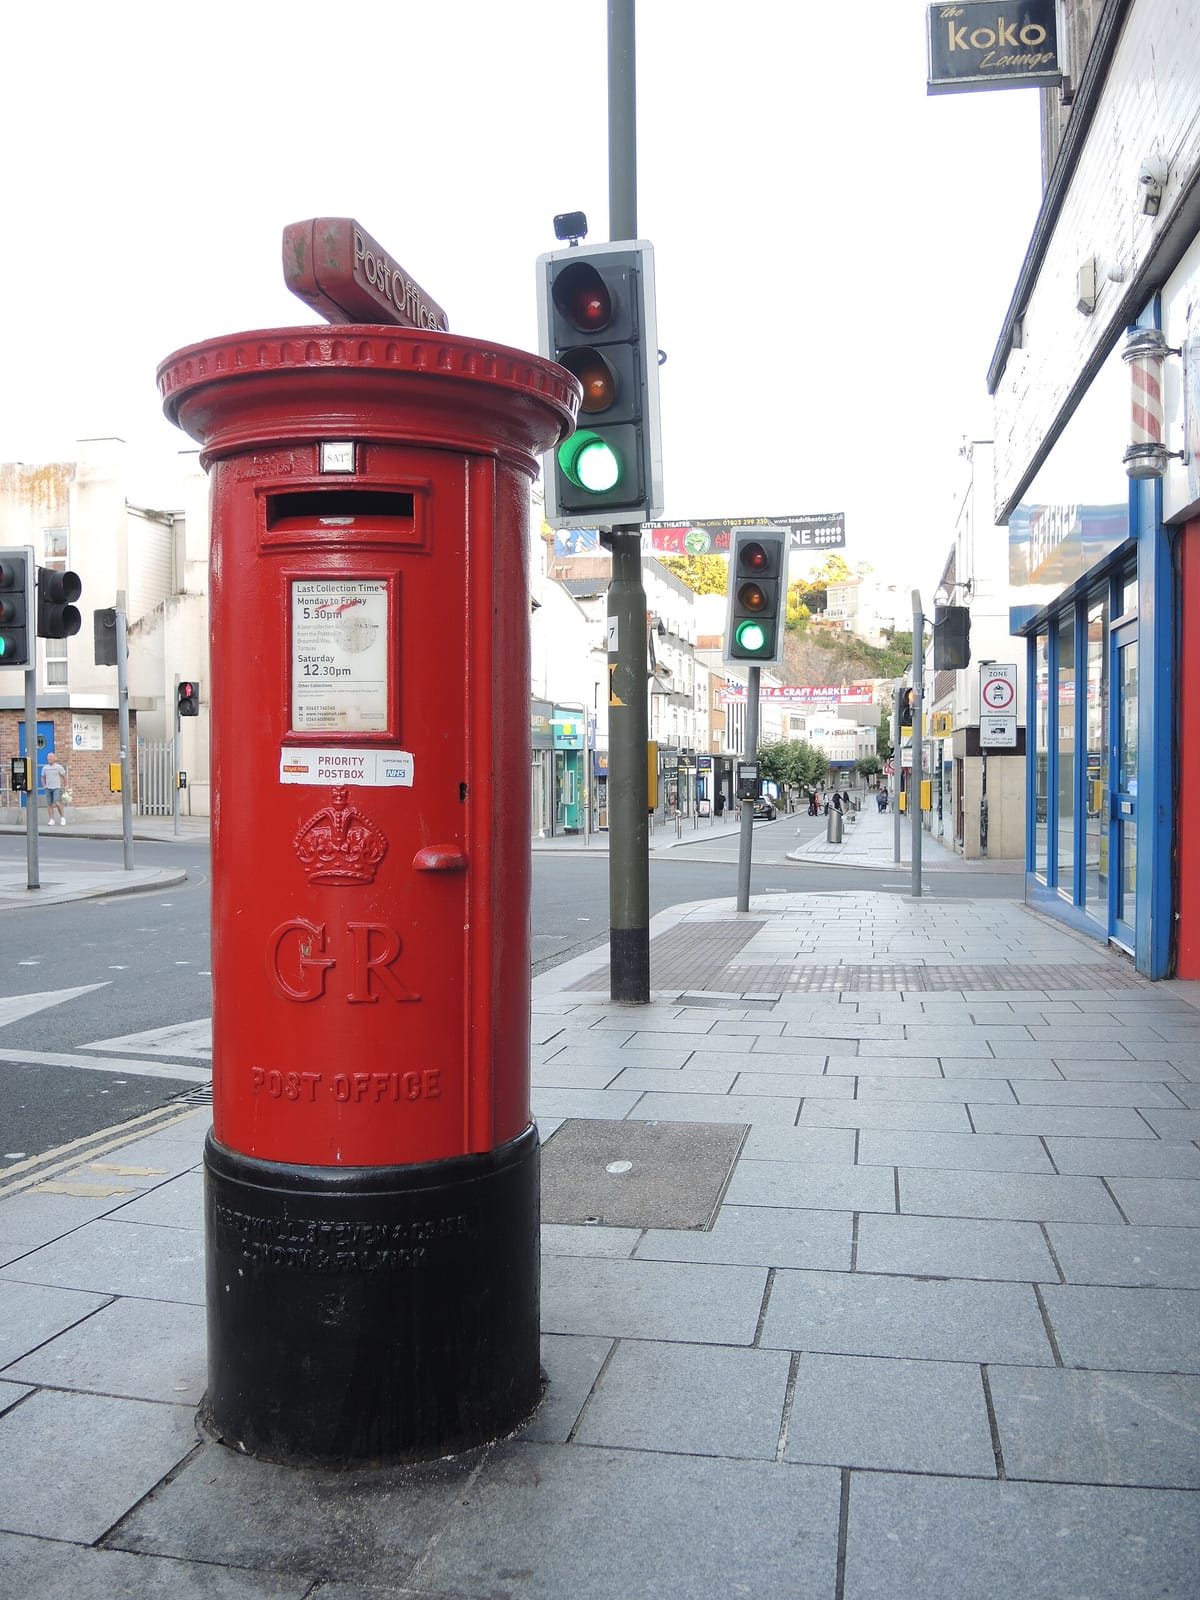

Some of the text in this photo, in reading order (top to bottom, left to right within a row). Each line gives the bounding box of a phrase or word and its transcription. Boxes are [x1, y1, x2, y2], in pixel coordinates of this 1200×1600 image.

[978, 50, 1056, 70] Lounge
[641, 521, 662, 529] LITTLE
[663, 520, 690, 529] THEATRE
[297, 584, 379, 593] Last Collection Time
[297, 597, 328, 606] Monday
[340, 596, 367, 606] Friday
[303, 607, 342, 620] 5.30pm
[298, 654, 335, 663] Saturday
[303, 664, 352, 677] 12.30pm
[773, 687, 782, 696] &
[783, 687, 811, 697] CRAFT
[813, 687, 850, 697] MARKET
[318, 756, 365, 766] PRIORITY
[318, 769, 364, 779] POSTBOX
[386, 769, 405, 777] NHS
[252, 1065, 442, 1104] POST OFFICE
